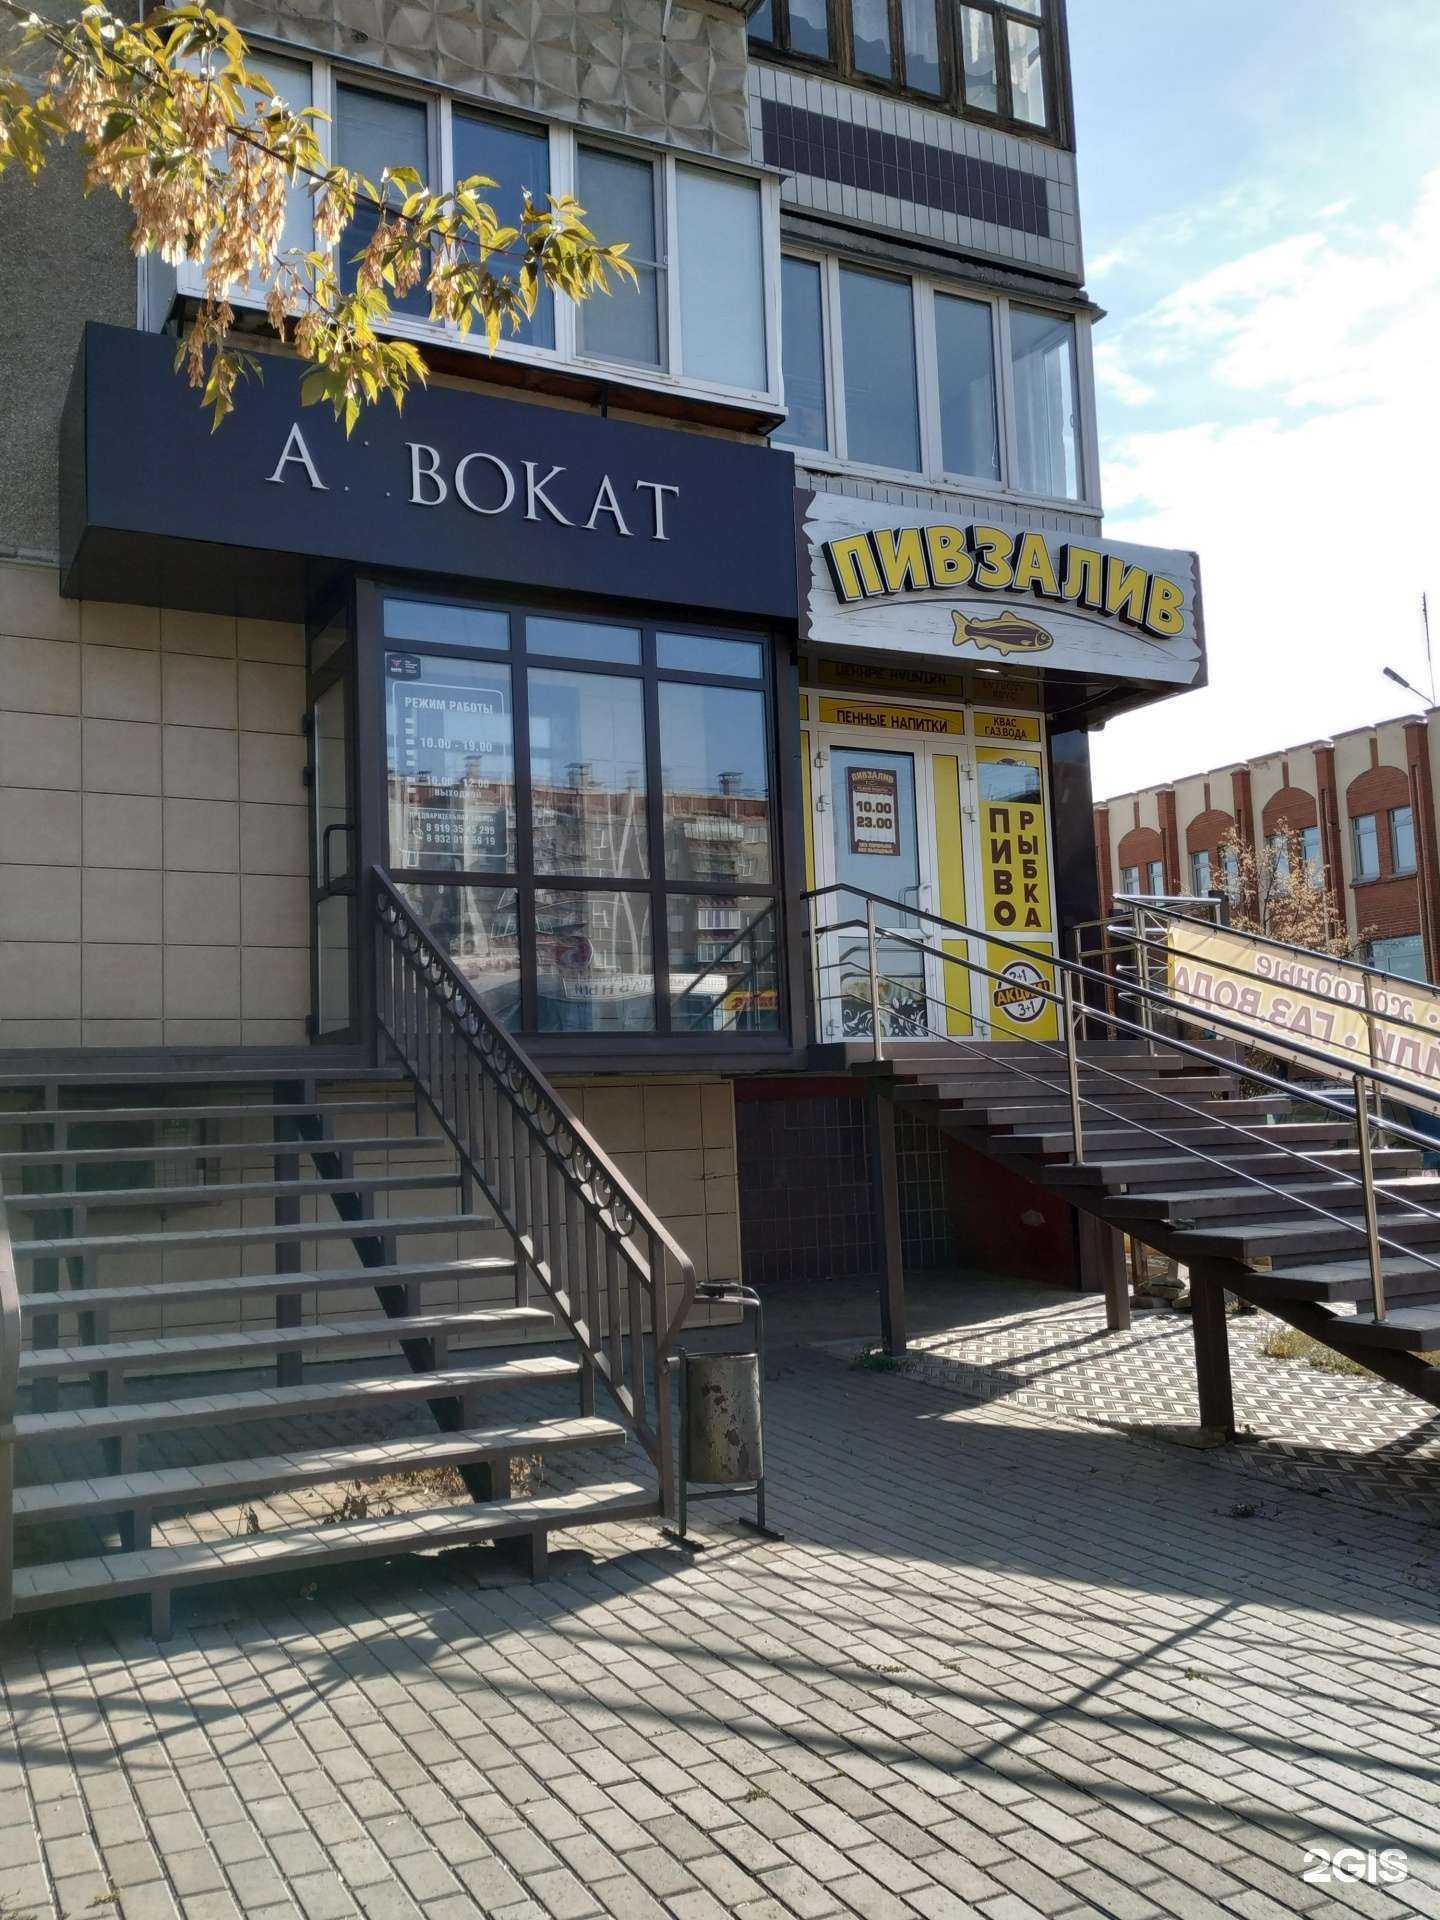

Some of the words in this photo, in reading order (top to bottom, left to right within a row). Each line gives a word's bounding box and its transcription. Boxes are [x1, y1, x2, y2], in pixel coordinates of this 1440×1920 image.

[821, 524, 1186, 639] ПИВЗАЛИВ
[405, 697, 446, 710] РЕЖИМ
[449, 701, 493, 714] РАБОТЫ
[837, 710, 887, 727] ПЕННЫЕ
[891, 716, 948, 732] НАПИТКИ
[993, 716, 1017, 728] КВАС
[421, 738, 451, 749] 10.00
[856, 800, 892, 814] 10.00
[856, 816, 893, 829] 23.00
[989, 807, 1016, 927] ПИВО
[1017, 810, 1042, 928] РЫБКА
[1018, 1000, 1036, 1017] 3+1
